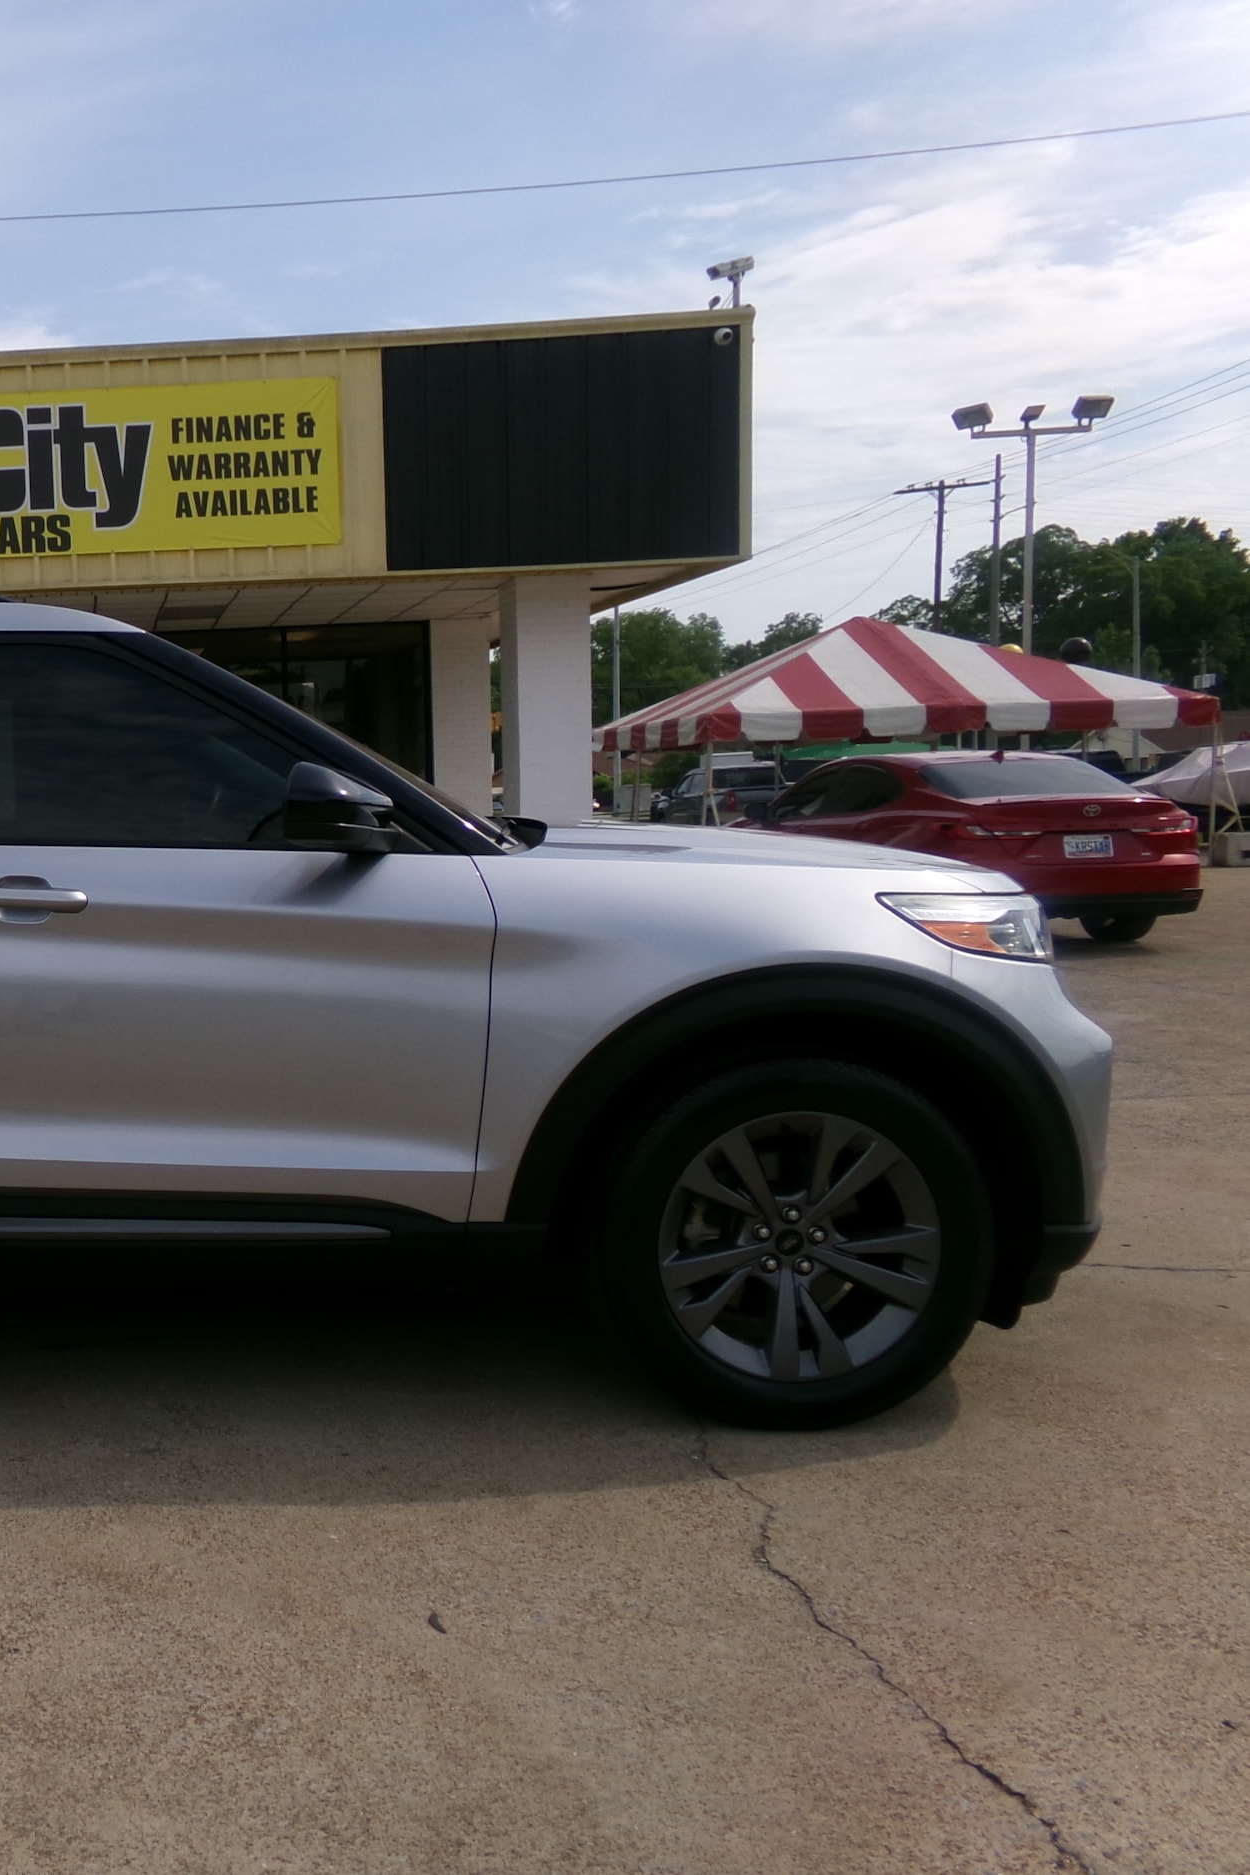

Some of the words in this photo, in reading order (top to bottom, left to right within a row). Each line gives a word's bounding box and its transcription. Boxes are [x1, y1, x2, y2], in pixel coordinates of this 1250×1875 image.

[171, 413, 285, 444] FINANCE
[297, 412, 316, 438] &
[168, 449, 322, 481] WARRANTY
[175, 486, 318, 518] AVAILABLE
